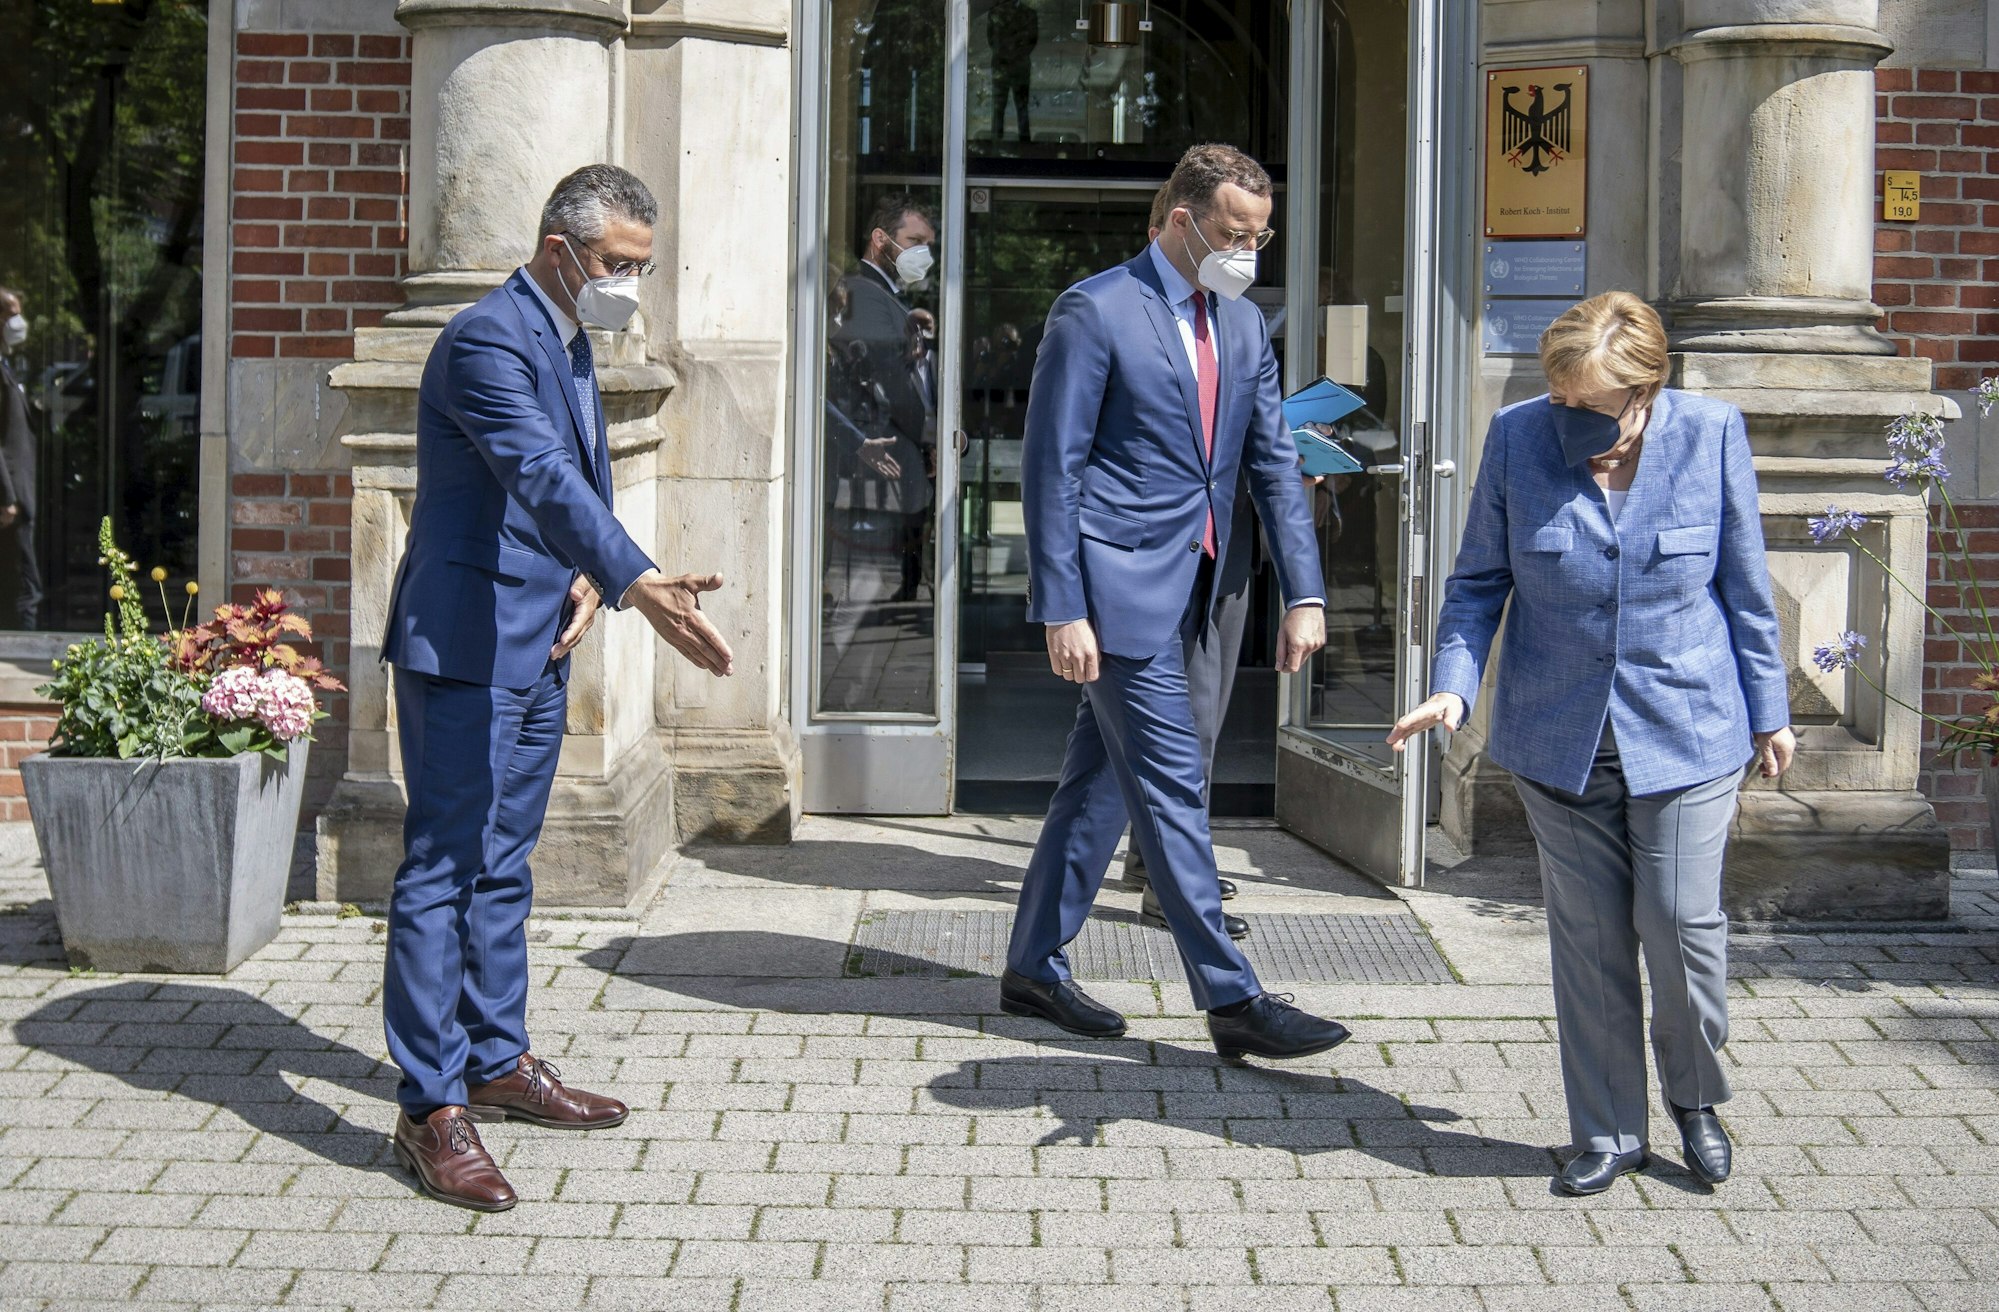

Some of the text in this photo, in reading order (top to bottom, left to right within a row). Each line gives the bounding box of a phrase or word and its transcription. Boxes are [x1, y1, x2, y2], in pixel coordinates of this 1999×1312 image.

[1887, 176, 1892, 186] S
[1500, 207, 1521, 215] Robert
[1523, 207, 1540, 215] Koch
[1546, 207, 1570, 215] Institut
